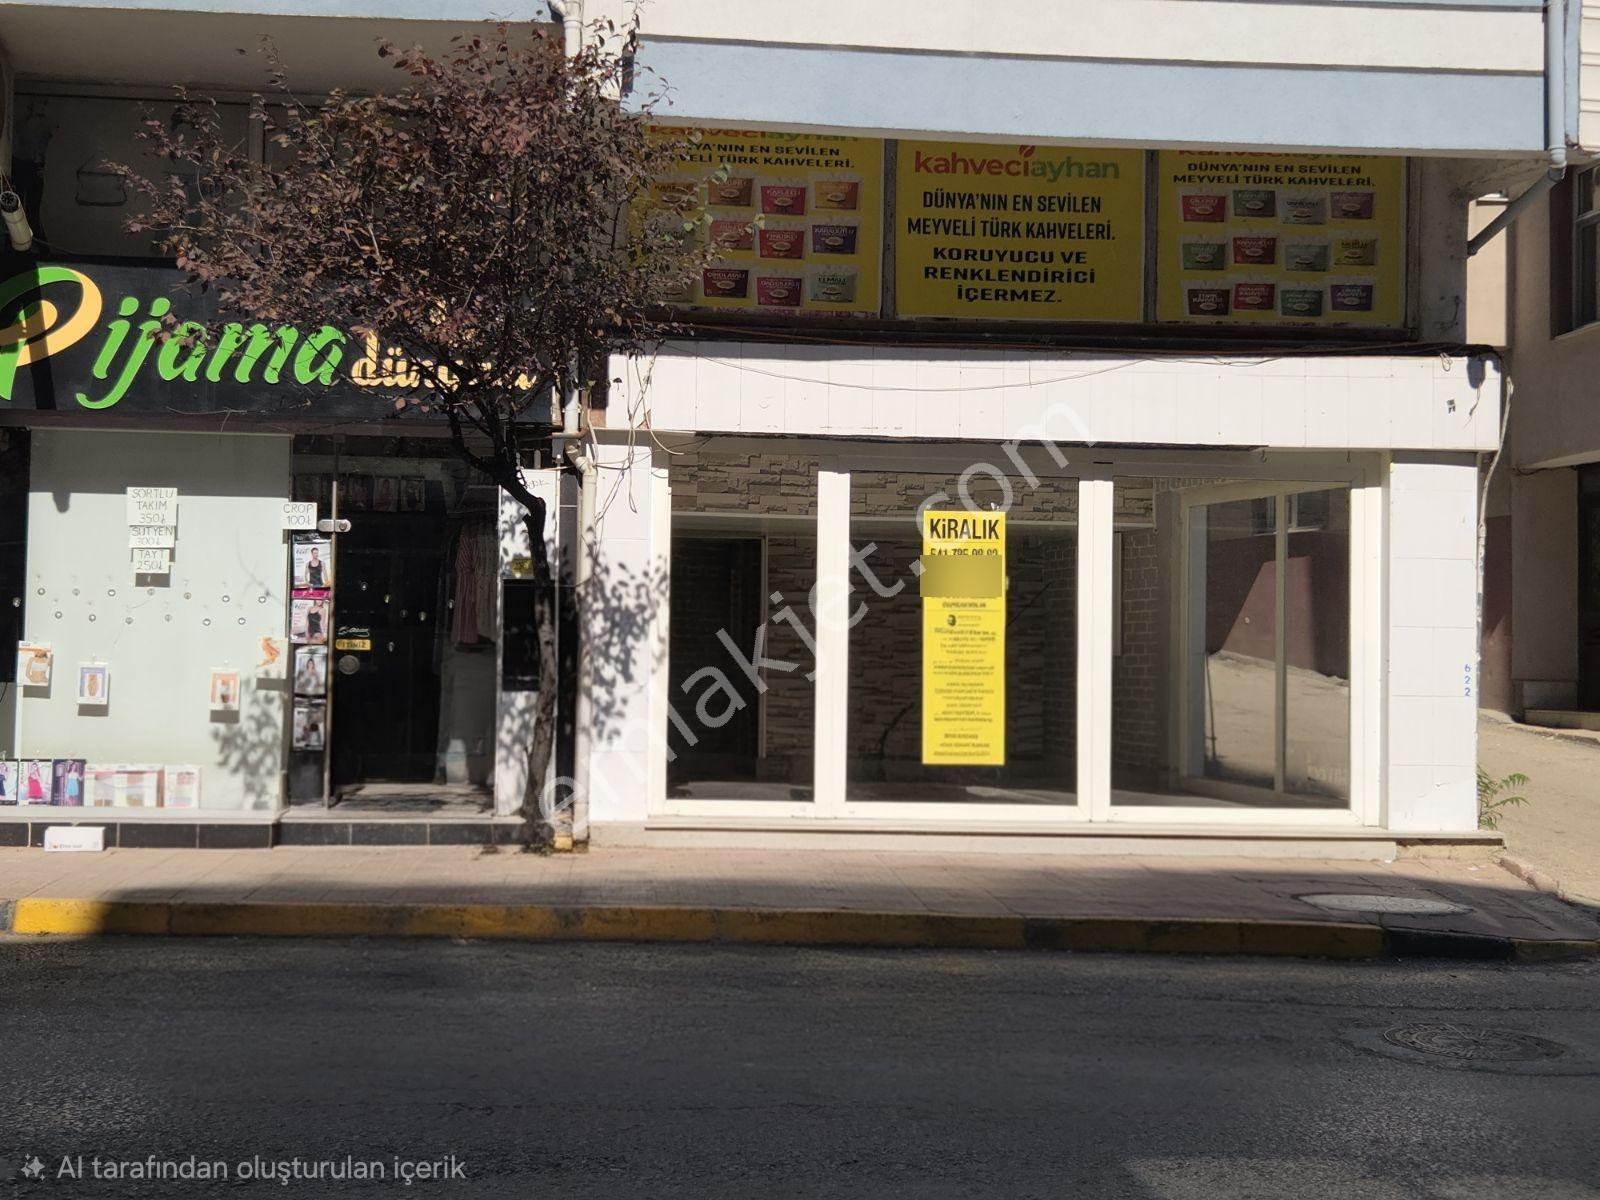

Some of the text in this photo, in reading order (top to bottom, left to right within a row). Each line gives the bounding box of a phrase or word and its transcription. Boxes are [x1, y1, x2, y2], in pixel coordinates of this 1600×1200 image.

[750, 145, 770, 153] EN
[775, 146, 840, 156] SEVİLEN
[718, 154, 759, 164] TÜRK
[915, 145, 1120, 183] kahveciayhan
[1188, 162, 1361, 174] DÜNYA'NIN EN SEVİLEN
[1173, 174, 1239, 184] MEYVELİ
[1243, 175, 1284, 185] TÜRK
[923, 188, 1101, 213] DÜNYA'NIN EN SEVİLEN
[907, 216, 1116, 241] MEYVELİ TÜRK KAHVELERİ.
[933, 247, 1088, 265] KORUYUCU VE
[924, 266, 1096, 284] RENKLENDİRİCİ
[957, 284, 1062, 303] İÇERMEZ.
[0, 265, 347, 409] Pijama
[136, 500, 168, 511] TAKIM
[283, 503, 314, 514] CROP
[138, 549, 165, 559] TAYT
